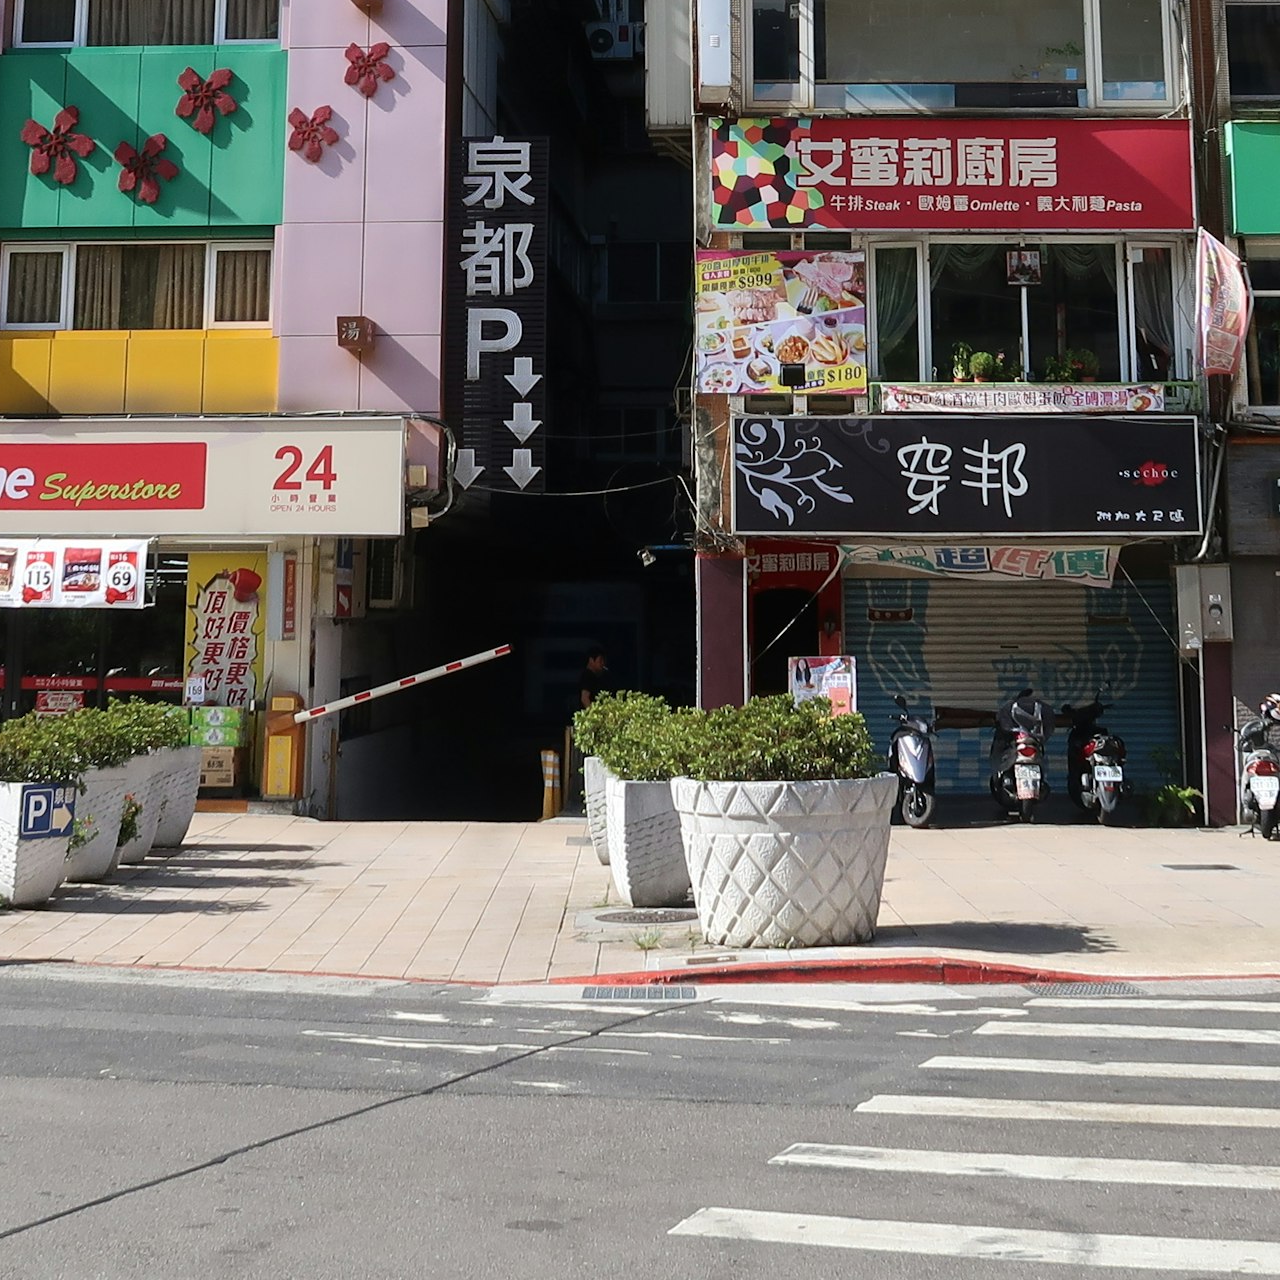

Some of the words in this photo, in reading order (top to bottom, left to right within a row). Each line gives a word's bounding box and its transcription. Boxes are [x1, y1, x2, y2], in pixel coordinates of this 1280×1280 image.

[797, 136, 1058, 188] 艾蜜莉廚房
[738, 272, 773, 290] $999
[827, 366, 862, 383] $180
[272, 445, 338, 491] 24
[38, 472, 182, 509] Superstore
[270, 504, 293, 512] OPEN
[295, 504, 305, 512] 24
[308, 504, 337, 512] HOURS
[27, 570, 51, 587] 115
[112, 573, 132, 587] 69
[202, 590, 228, 692] 頂好更好
[27, 794, 48, 829] P
